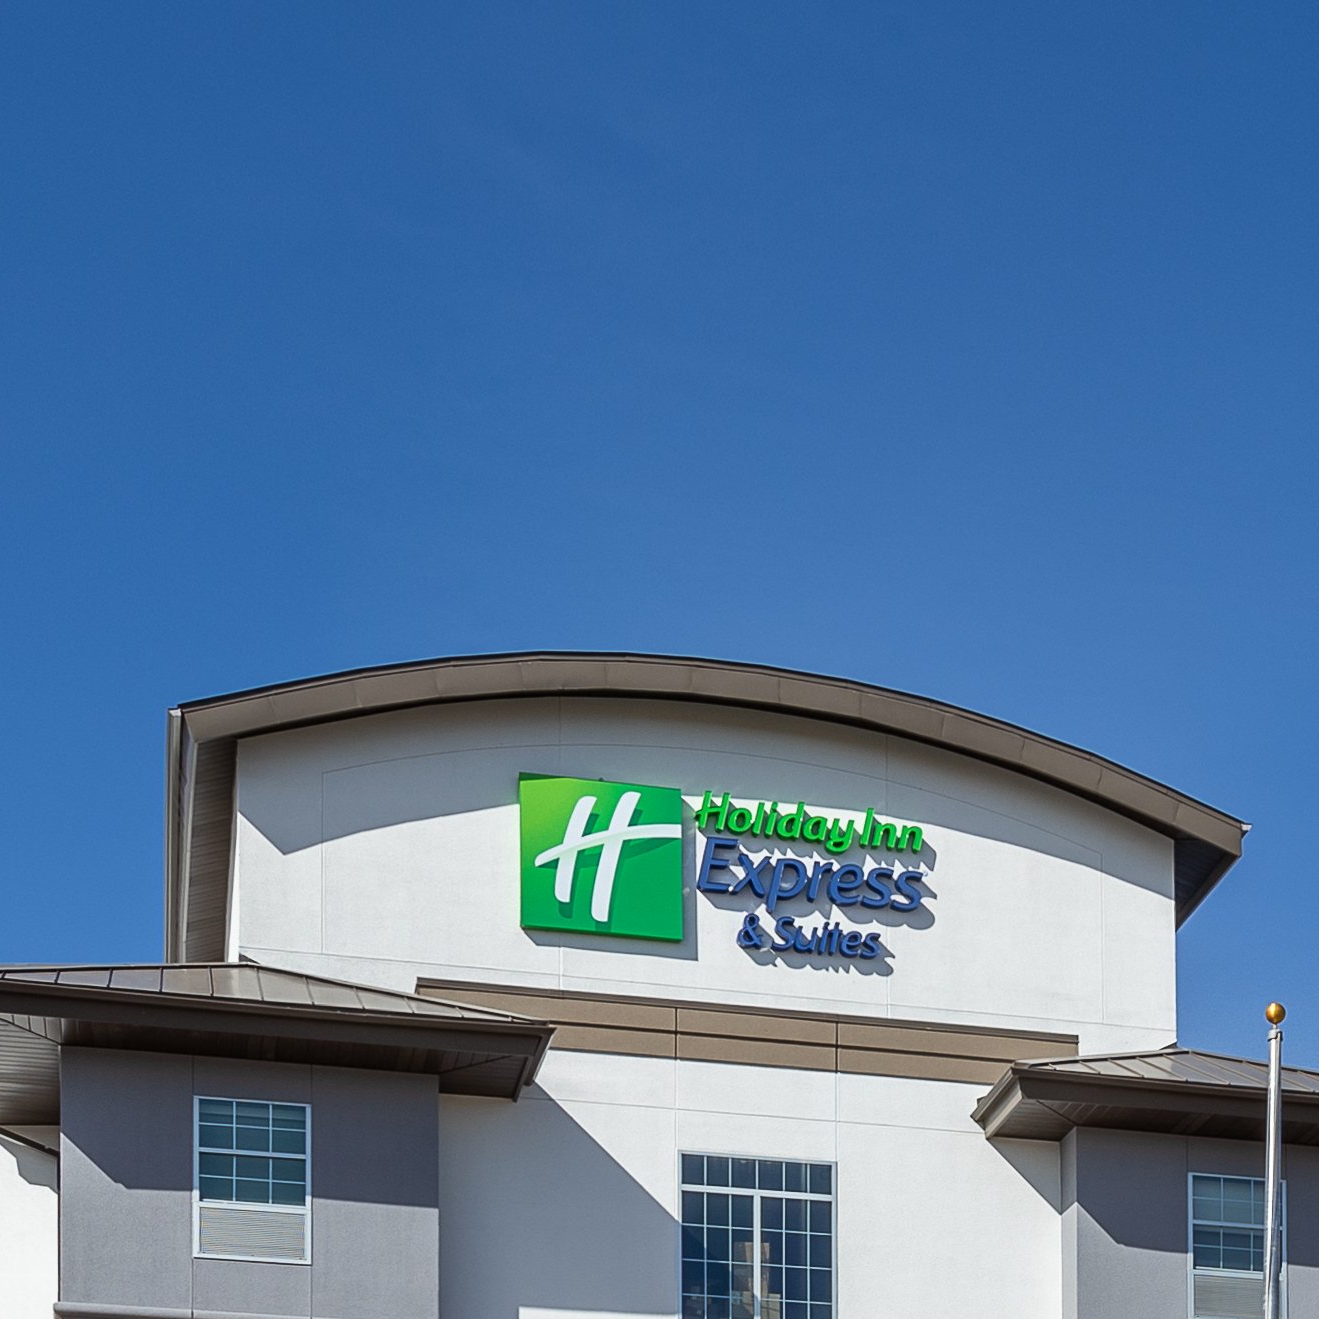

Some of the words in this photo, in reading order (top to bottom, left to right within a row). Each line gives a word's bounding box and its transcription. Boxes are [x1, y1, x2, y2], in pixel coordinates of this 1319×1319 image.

[694, 790, 855, 853] Holiday
[859, 807, 924, 853] Inn
[696, 836, 925, 913] Express
[736, 913, 764, 949] &
[772, 916, 881, 960] Suites
